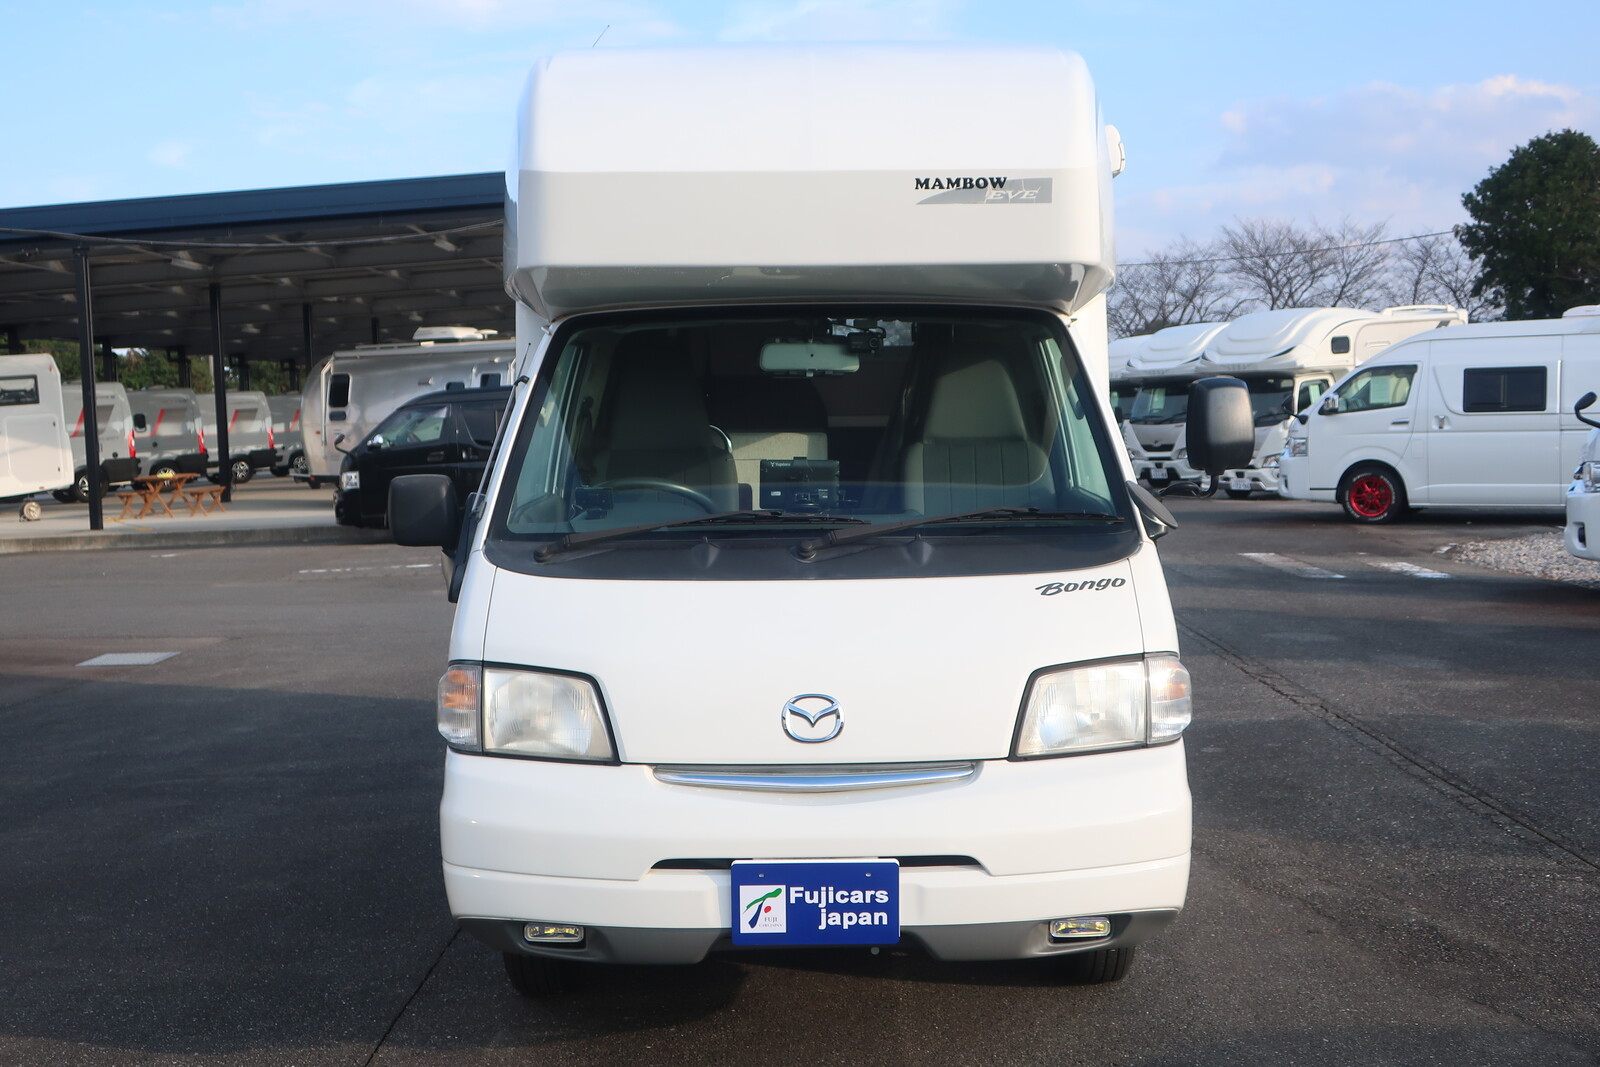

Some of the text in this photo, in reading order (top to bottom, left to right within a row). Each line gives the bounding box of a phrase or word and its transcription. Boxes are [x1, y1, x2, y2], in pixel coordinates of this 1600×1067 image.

[914, 177, 1007, 190] MAMBOW
[986, 189, 1040, 200] EVE
[1034, 577, 1126, 596] Bongo
[789, 886, 889, 908] Fujicars
[818, 908, 888, 930] japan
